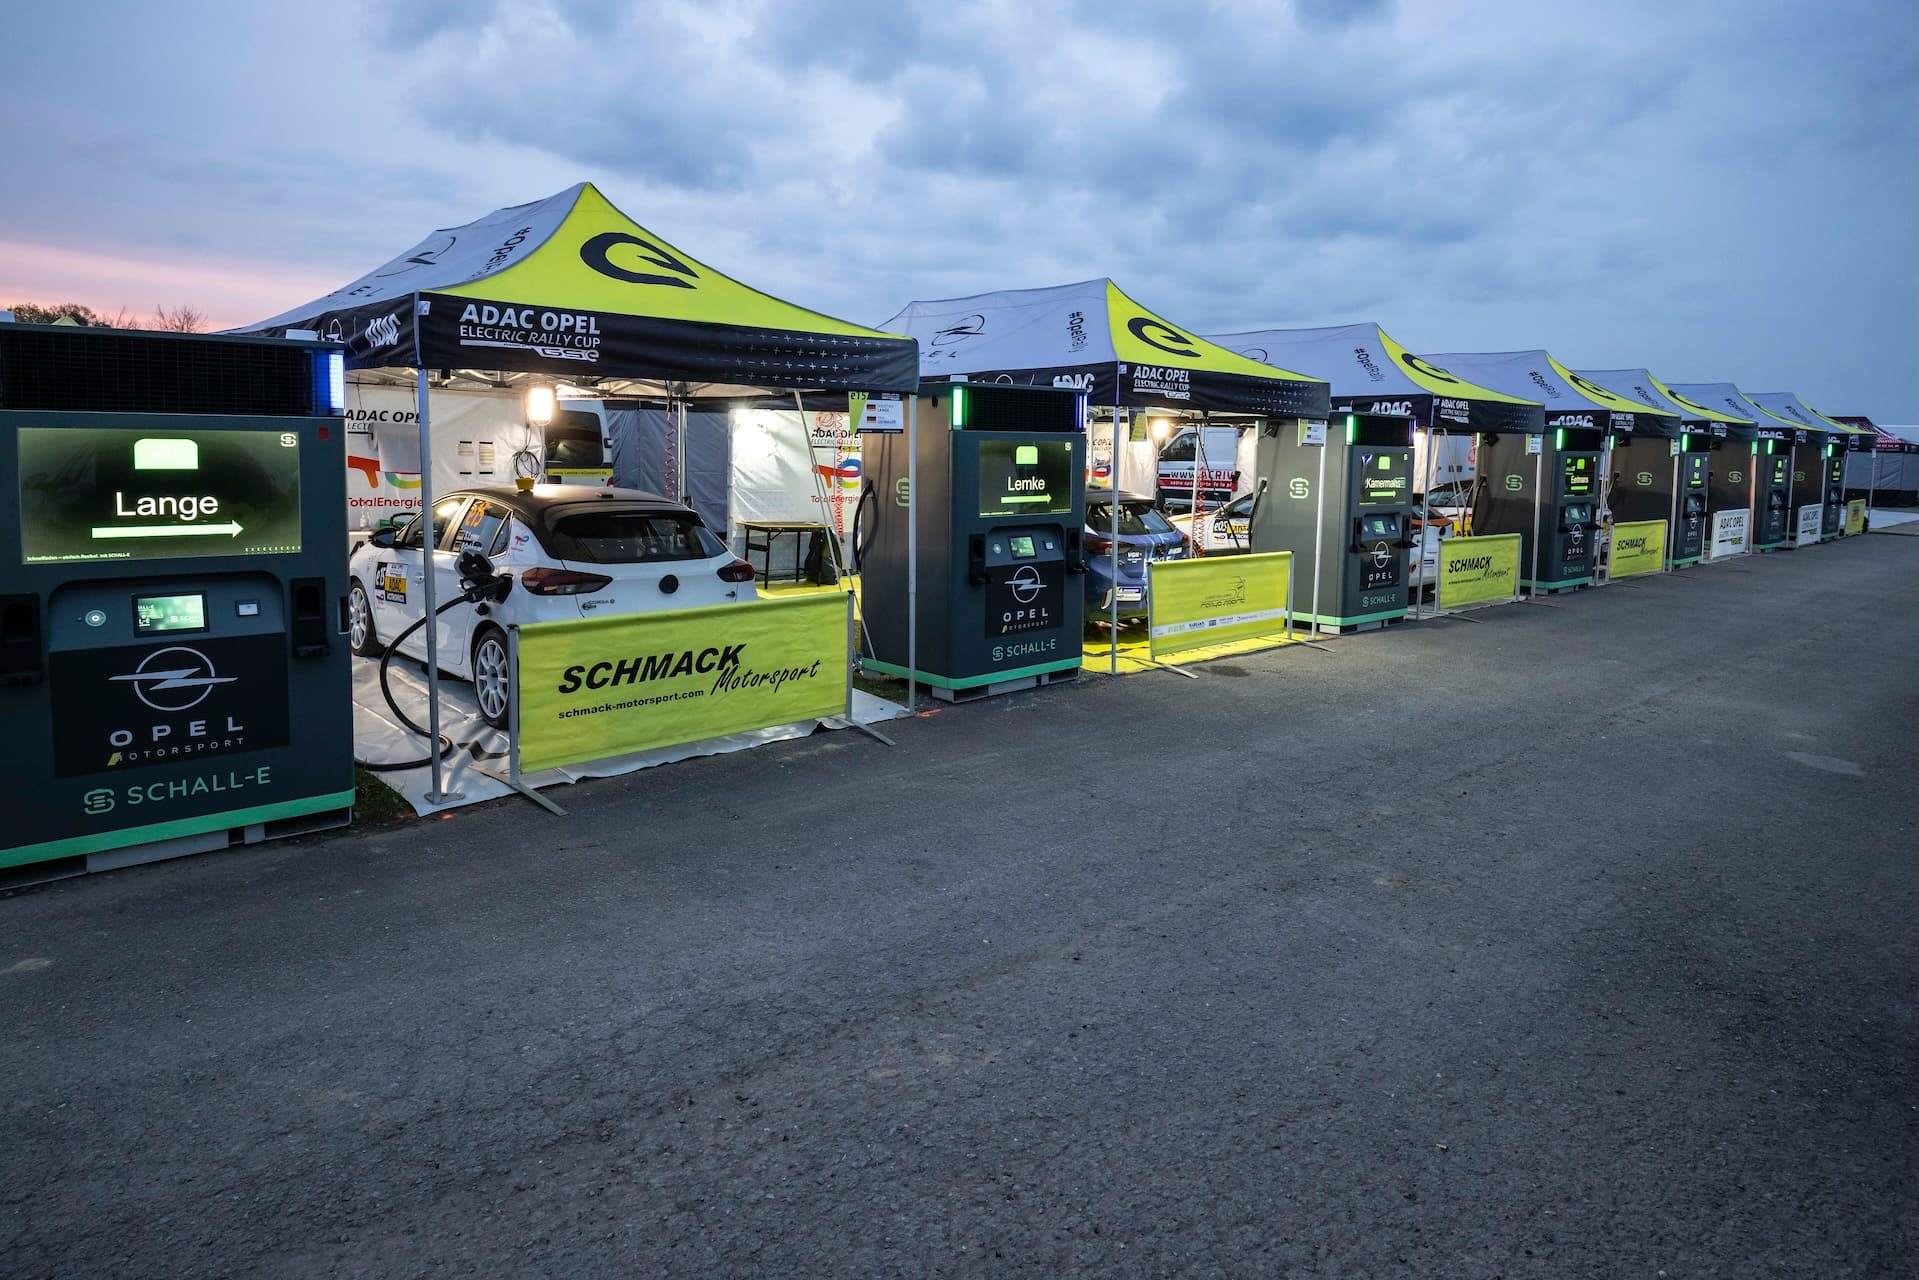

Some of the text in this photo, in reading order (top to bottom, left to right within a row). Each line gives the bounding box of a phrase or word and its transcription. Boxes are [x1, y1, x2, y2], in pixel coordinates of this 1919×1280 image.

[459, 303, 601, 335] ADAC OPEL
[459, 325, 601, 348] ELECTRIC RALLY CUP
[1133, 365, 1190, 382] ADAC OPEL
[1134, 379, 1160, 389] ELECTRIC
[345, 410, 389, 422] ADAC
[1370, 401, 1412, 416] ADAC
[1007, 476, 1045, 491] Lemke
[115, 491, 219, 520] Lange
[348, 497, 423, 509] otalEnergie
[1448, 556, 1492, 574] SCHMACK
[1368, 572, 1393, 581] OPEL
[1003, 607, 1049, 623] OPEL
[1006, 639, 1057, 658] SCHALL-E
[558, 643, 821, 696] SCHMACK Motorsport
[558, 689, 704, 719] schmack-motorsport.com
[109, 716, 244, 747] OPEL
[127, 766, 272, 805] SCHALL-E
